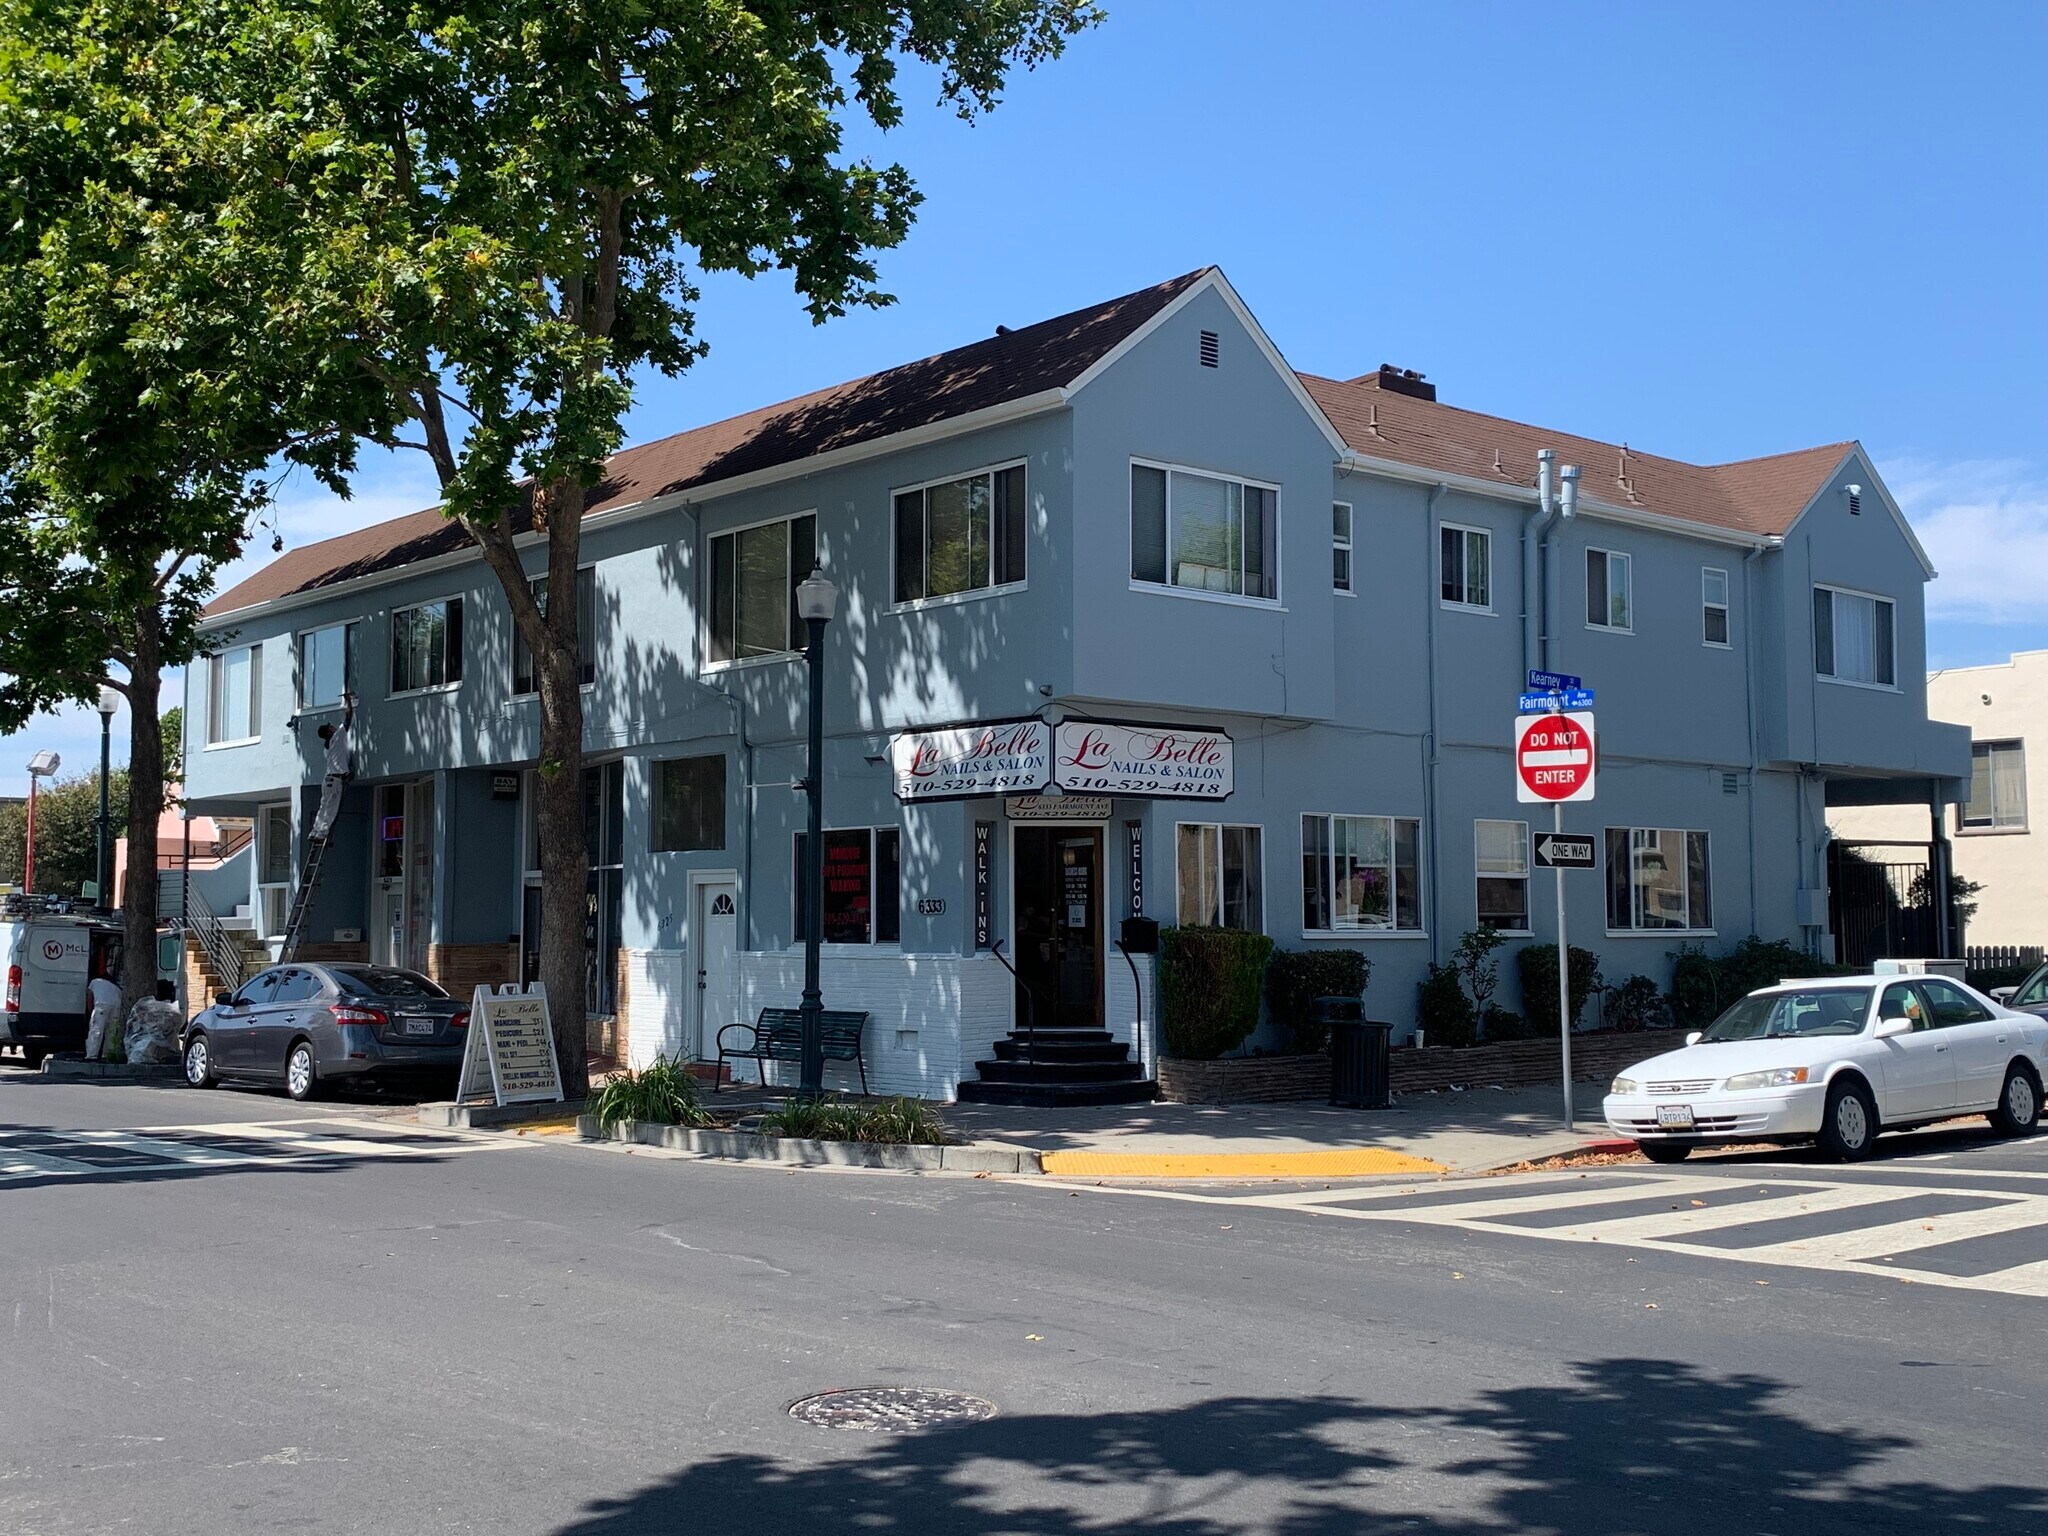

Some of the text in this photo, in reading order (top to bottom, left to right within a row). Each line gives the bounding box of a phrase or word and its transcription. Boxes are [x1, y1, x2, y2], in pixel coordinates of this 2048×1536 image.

[1531, 671, 1560, 689] Kearney
[1520, 694, 1569, 709] Fairmount
[1058, 724, 1224, 769] La Belle
[1530, 731, 1579, 747] DO NOT
[898, 724, 1044, 776] La Belle
[941, 756, 1045, 776] NAILS & SALON
[1111, 761, 1225, 779] NAILS & SALON
[900, 775, 1035, 793] 510-529-4818
[1535, 769, 1575, 784] ENTER
[1065, 777, 1220, 794] 510-529-4818
[1552, 844, 1589, 858] ONE WAY
[47, 945, 59, 955] M
[66, 944, 88, 952] McL
[512, 1003, 540, 1015] Belle
[502, 1081, 555, 1090] 510-529-4818
